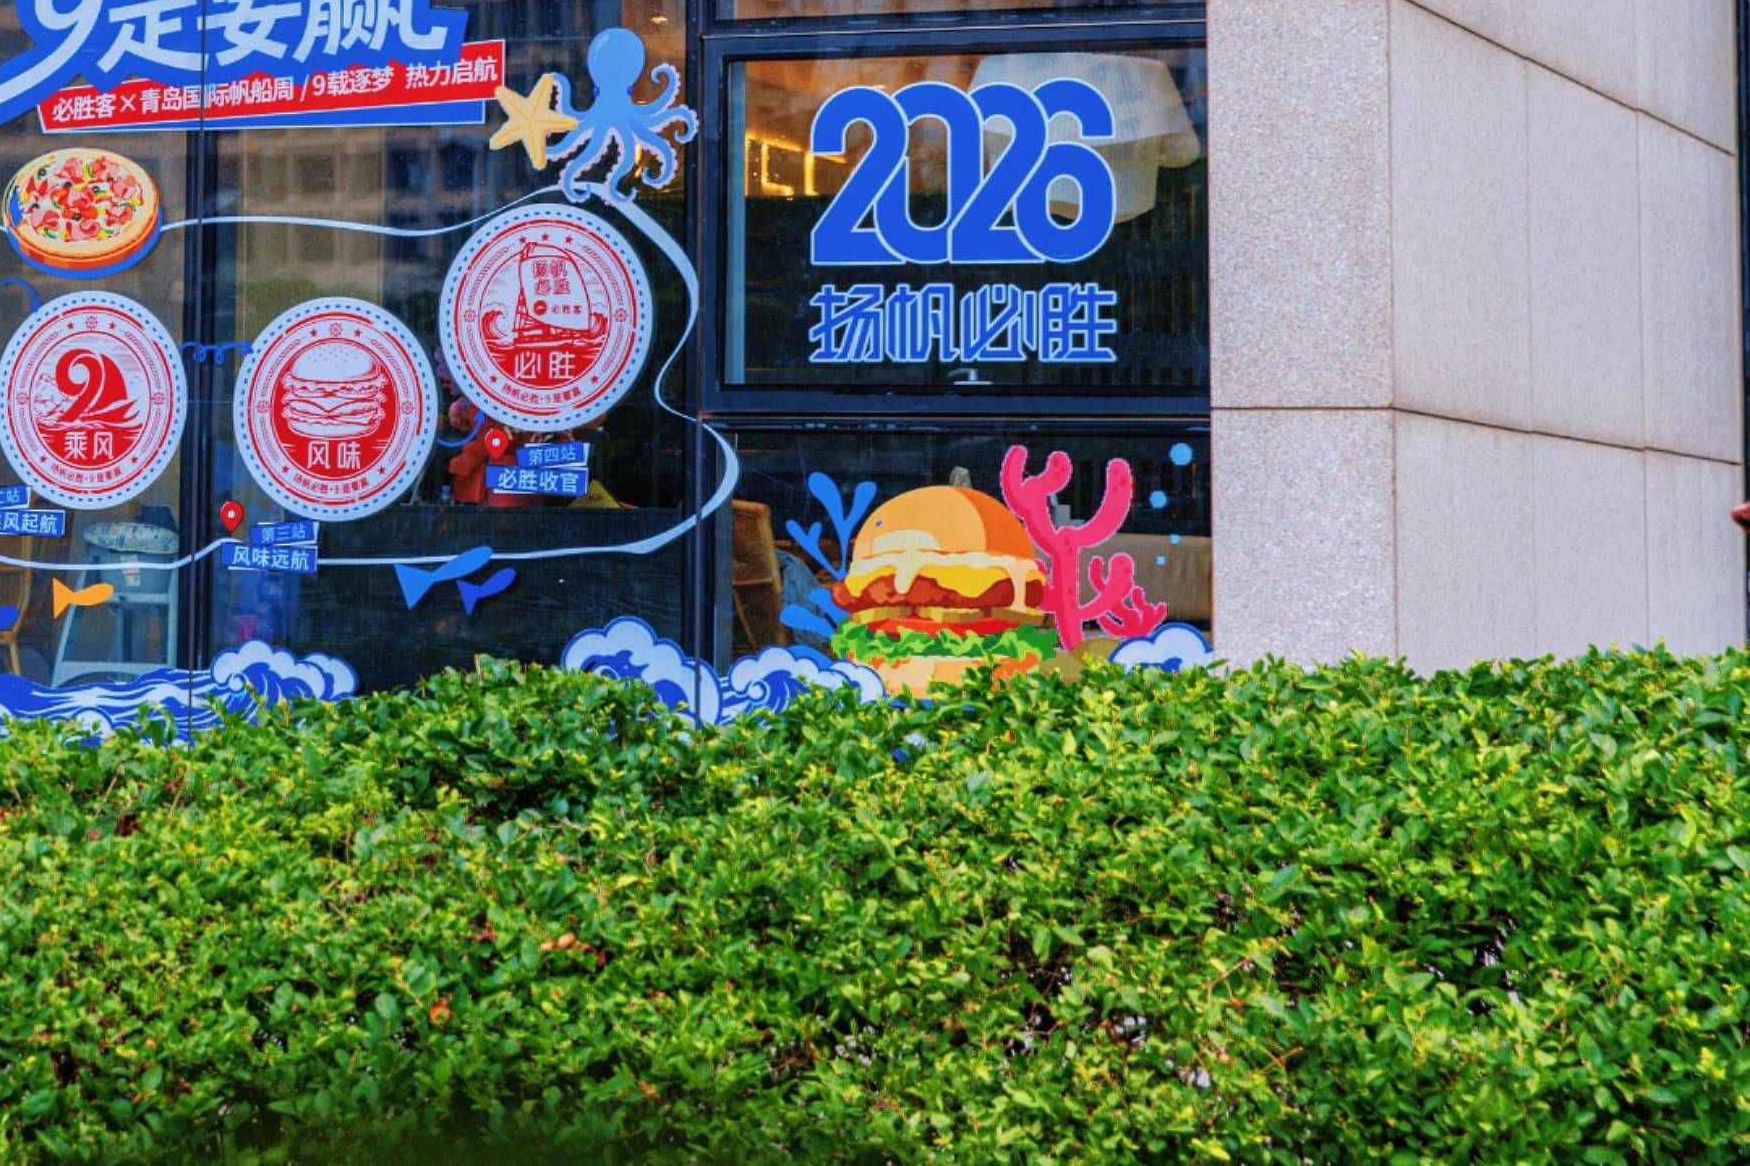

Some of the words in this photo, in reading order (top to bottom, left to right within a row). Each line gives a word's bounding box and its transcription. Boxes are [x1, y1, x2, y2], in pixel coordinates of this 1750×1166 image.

[810, 78, 1116, 265] 2026
[808, 282, 1117, 363] 扬帆必胜
[514, 351, 576, 379] 必胜
[64, 431, 114, 459] 乘风
[307, 441, 361, 469] 风味
[529, 445, 576, 465] 第四站
[497, 467, 580, 493] 必胜收官
[261, 524, 306, 544] 第三站
[232, 546, 310, 571] 风味远航
